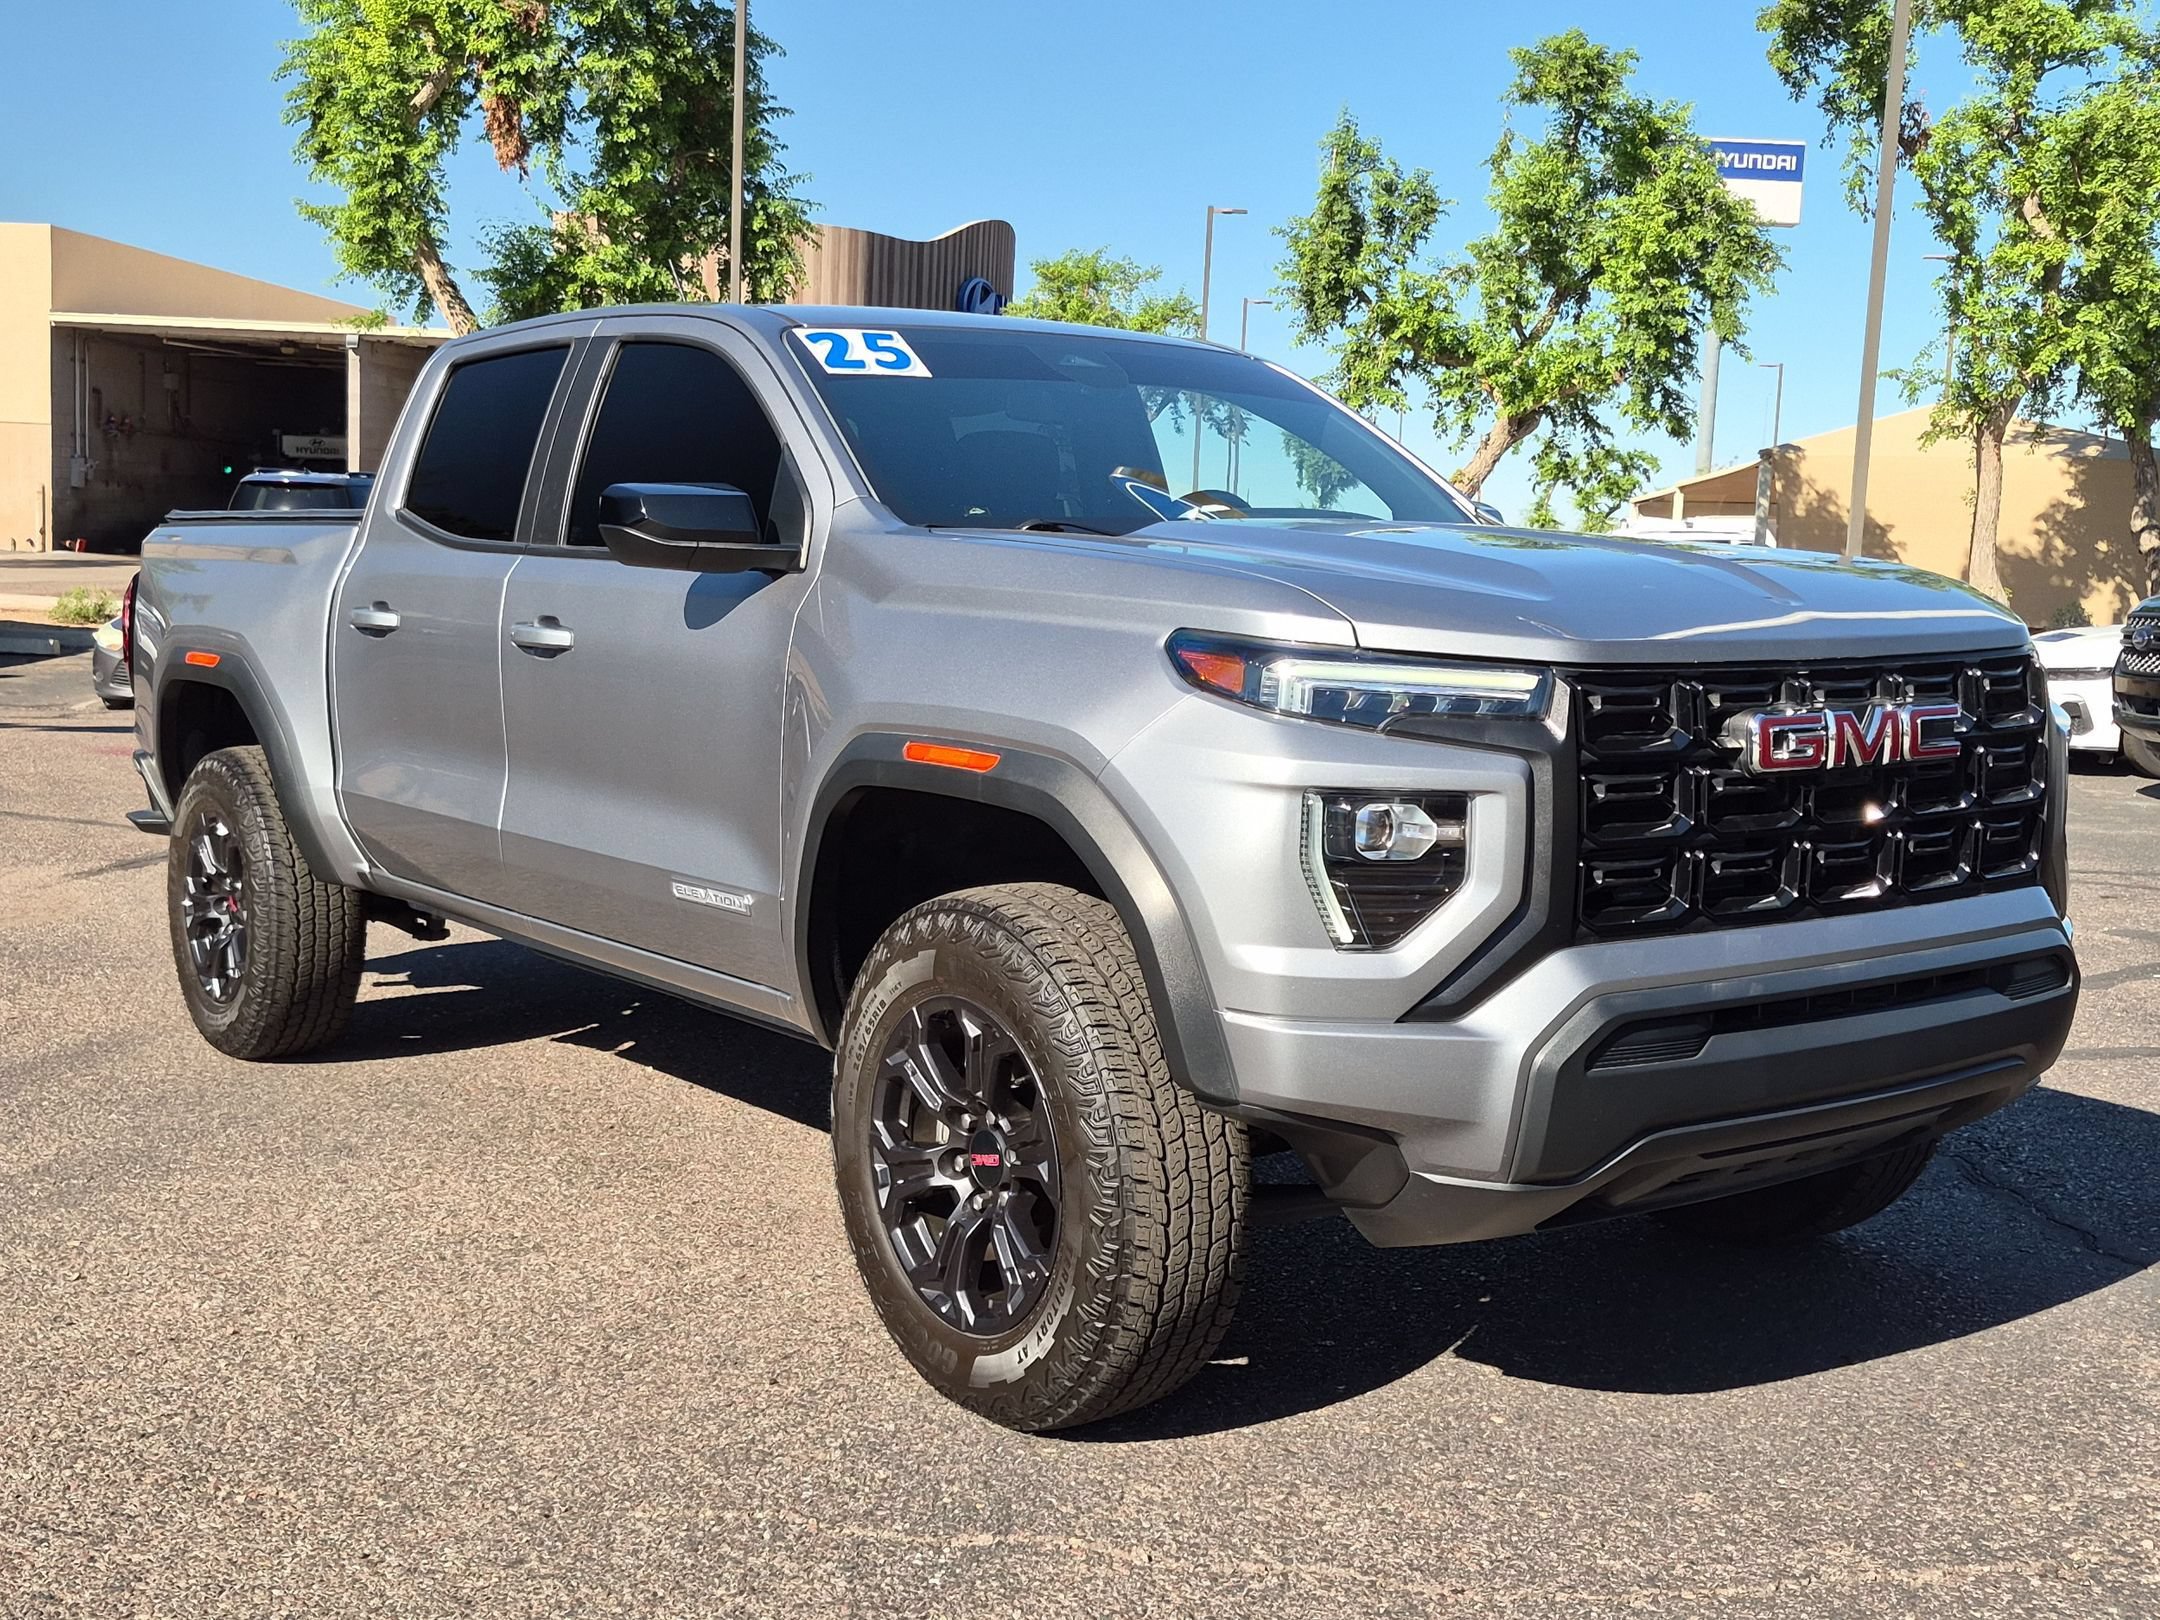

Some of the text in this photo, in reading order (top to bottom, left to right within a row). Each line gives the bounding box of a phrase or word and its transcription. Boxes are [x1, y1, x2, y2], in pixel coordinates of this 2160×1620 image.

[805, 332, 912, 370] 25
[295, 446, 340, 456] HYUNDAI
[1751, 703, 1962, 772] GMC
[674, 884, 747, 912] ELEVATION
[1017, 1344, 1029, 1365] AT
